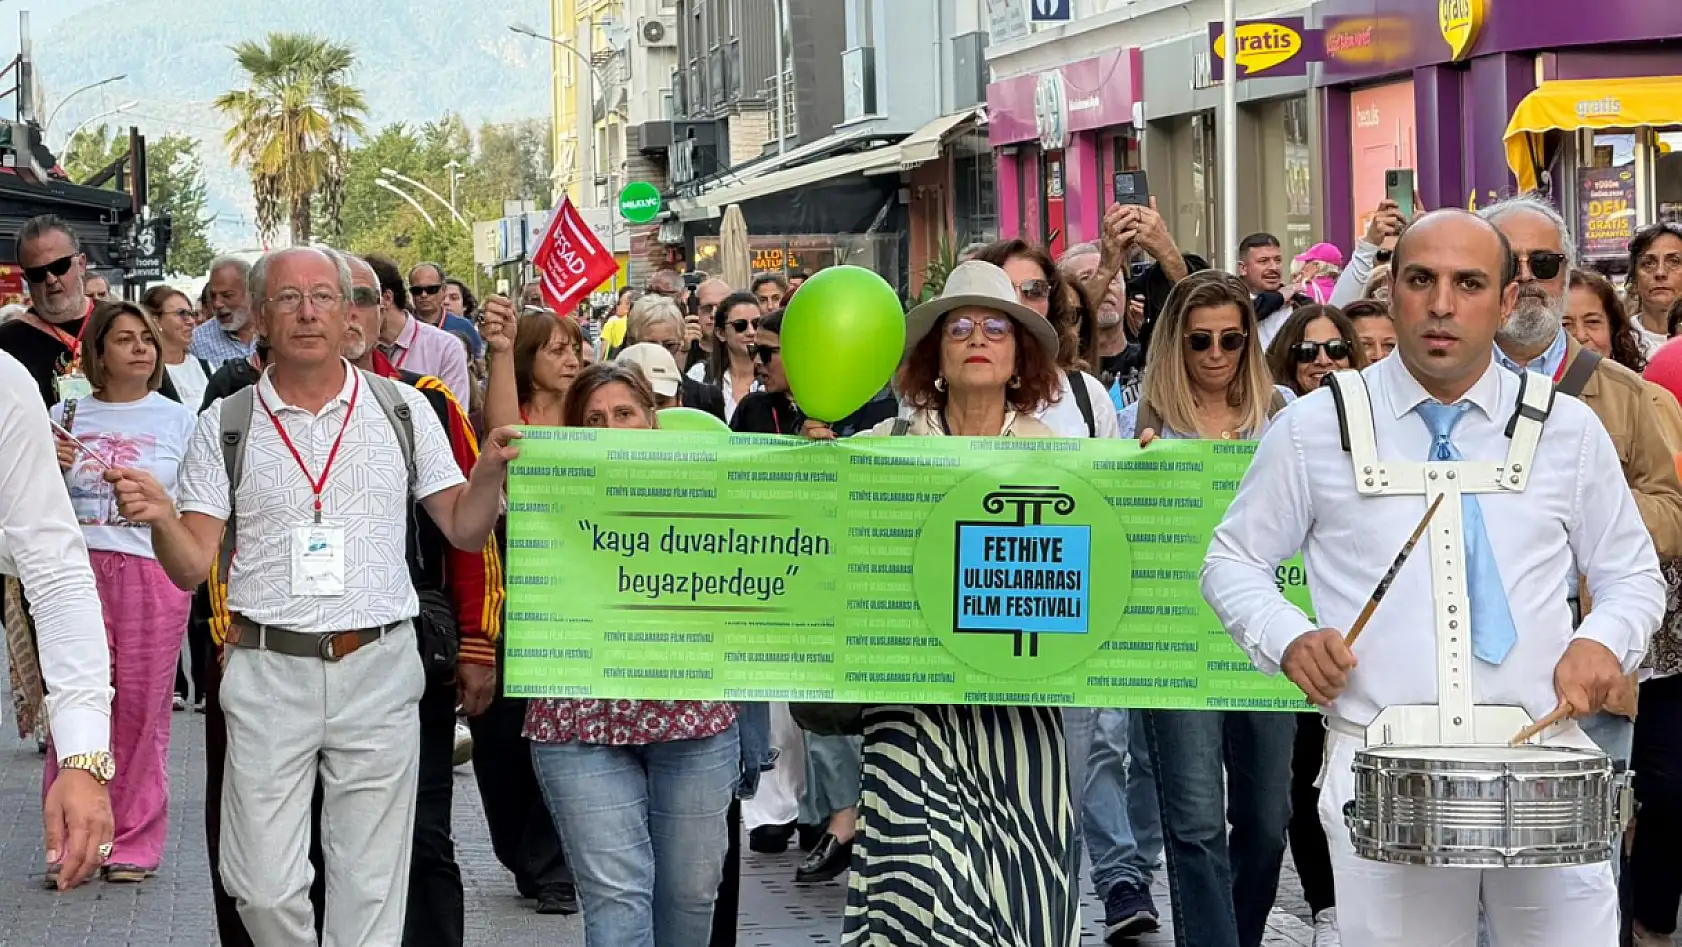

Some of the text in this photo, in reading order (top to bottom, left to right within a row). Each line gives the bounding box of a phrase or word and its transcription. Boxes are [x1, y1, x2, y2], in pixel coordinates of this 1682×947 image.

[1236, 29, 1291, 53] ratis
[1576, 95, 1621, 117] gratis
[135, 256, 159, 266] hone
[660, 525, 830, 557] duvarlarından
[964, 568, 1081, 591] ULUSLARARASI
